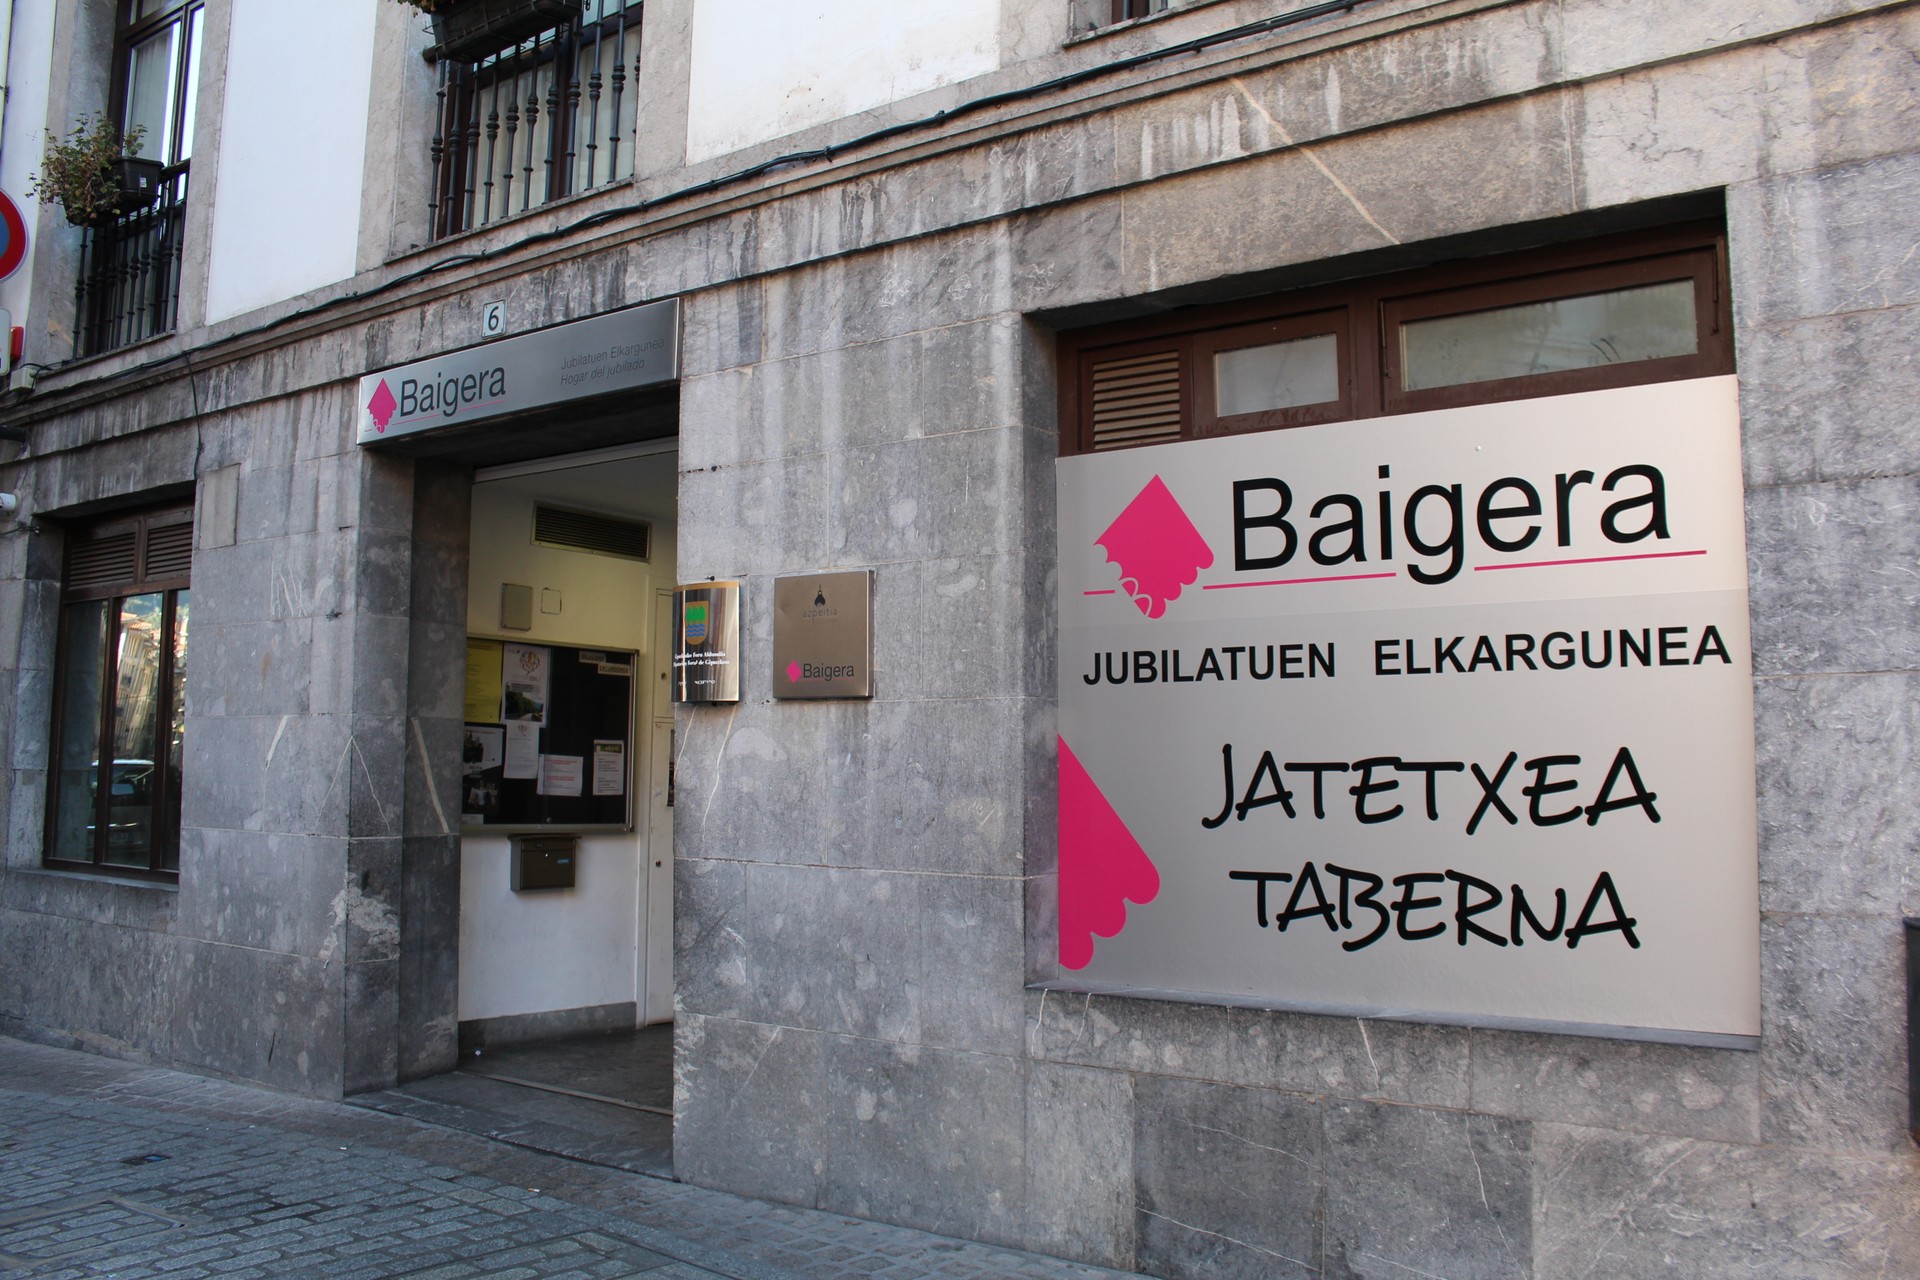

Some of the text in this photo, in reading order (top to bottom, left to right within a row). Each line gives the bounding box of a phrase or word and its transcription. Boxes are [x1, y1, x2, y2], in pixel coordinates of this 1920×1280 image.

[487, 306, 500, 331] 6
[560, 358, 645, 386] Hogar del jubilado
[561, 338, 665, 370] Jubilatuen Elkargunea
[400, 366, 506, 417] Baigera
[1231, 463, 1671, 585] Baigera
[803, 662, 854, 682] Baigera
[1082, 625, 1732, 686] JUBILATUEN ELKARGUNEA
[1200, 743, 1662, 835] JATETXEA
[1228, 861, 1641, 952] TABERNA
